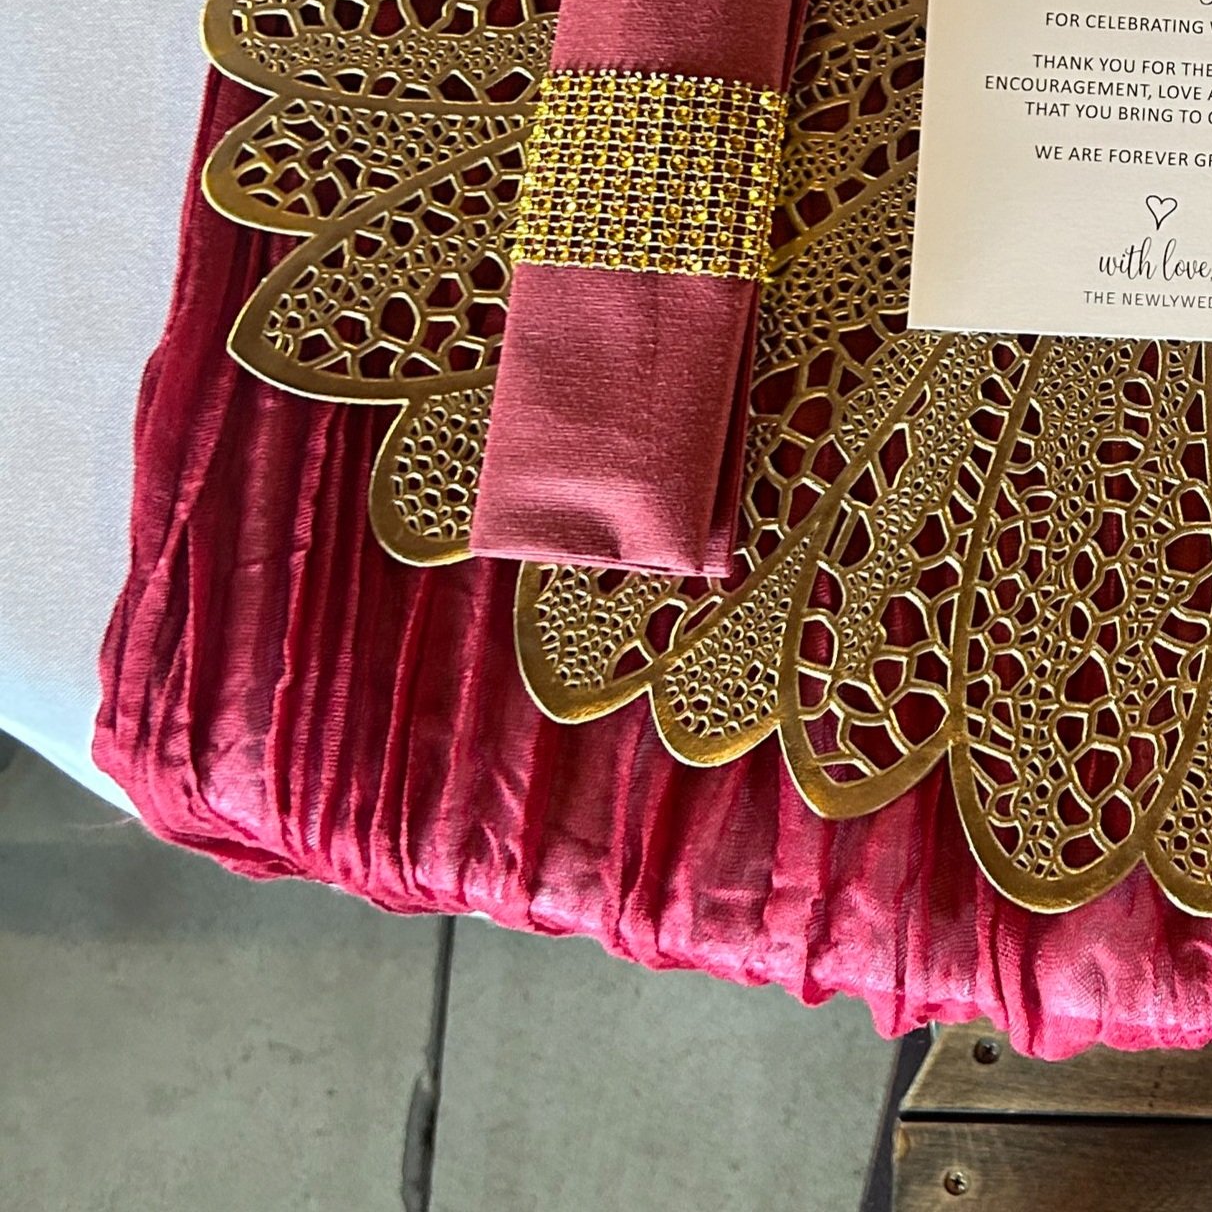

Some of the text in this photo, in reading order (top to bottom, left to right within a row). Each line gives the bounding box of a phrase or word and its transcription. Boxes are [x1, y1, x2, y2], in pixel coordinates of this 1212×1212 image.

[1045, 11, 1080, 28] FOR
[1085, 14, 1204, 35] CELEBRATING
[1032, 53, 1094, 72] THANK
[1098, 57, 1136, 74] YOU
[1141, 59, 1176, 76] FOR
[985, 75, 1152, 101] ENCOURAGEMENT,
[1158, 84, 1202, 101] LOVE
[1024, 101, 1071, 118] THAT
[1075, 103, 1112, 120] YOU
[1118, 106, 1173, 123] BRING
[1178, 109, 1202, 125] TO
[1034, 144, 1063, 161] WE
[1067, 146, 1103, 163] ARE
[1108, 148, 1189, 167] FOREVER
[1098, 236, 1157, 280] with
[1083, 290, 1116, 305] THE
